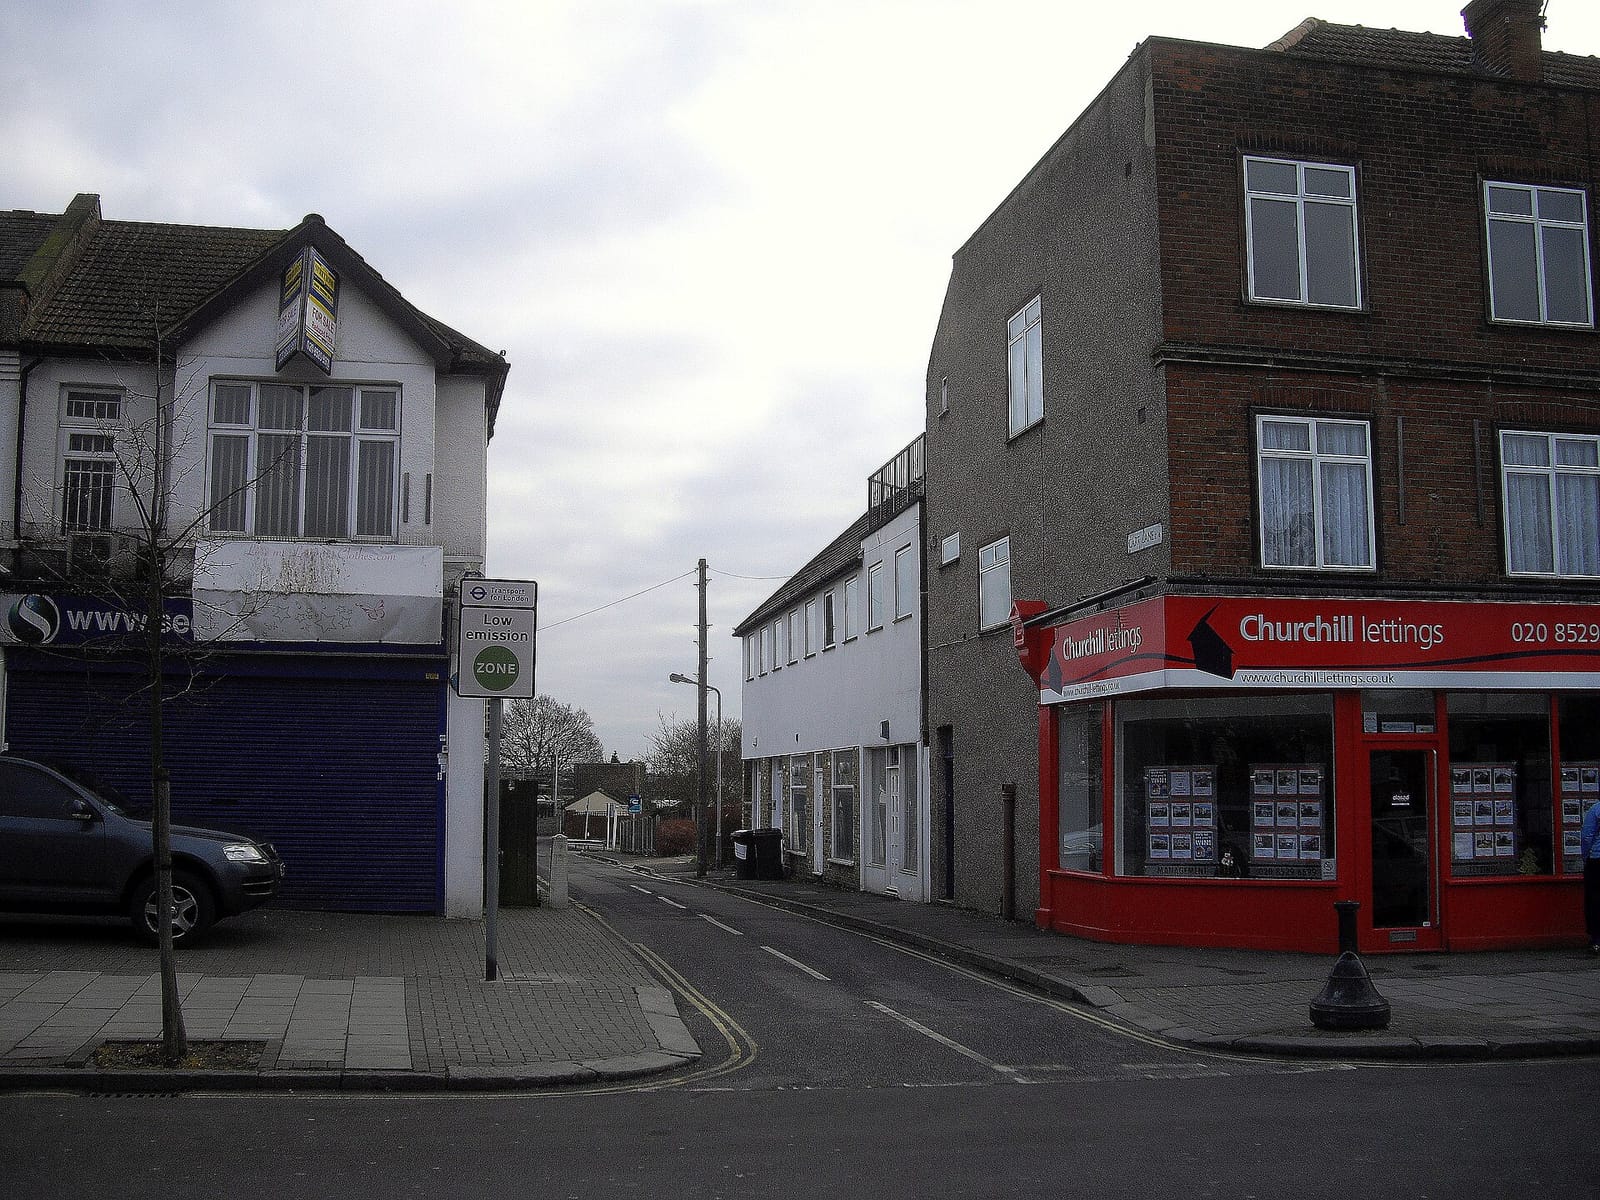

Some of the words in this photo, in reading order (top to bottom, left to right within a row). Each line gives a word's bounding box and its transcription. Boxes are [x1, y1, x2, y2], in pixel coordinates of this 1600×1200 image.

[322, 315, 336, 334] SALE
[491, 587, 526, 597] Transport
[503, 594, 529, 602] London
[483, 613, 513, 626] Low
[465, 629, 528, 642] emission
[1239, 613, 1354, 642] Churchill
[1361, 615, 1445, 650] lettings
[1511, 622, 1548, 642] 020
[1554, 623, 1600, 643] 8529
[1062, 628, 1105, 661] Churchill
[1106, 624, 1142, 653] lettings
[476, 662, 516, 674] ZONE
[1240, 672, 1395, 686] www.churchill-lettings.co.uk
[1157, 866, 1207, 874] MANAGEMENT
